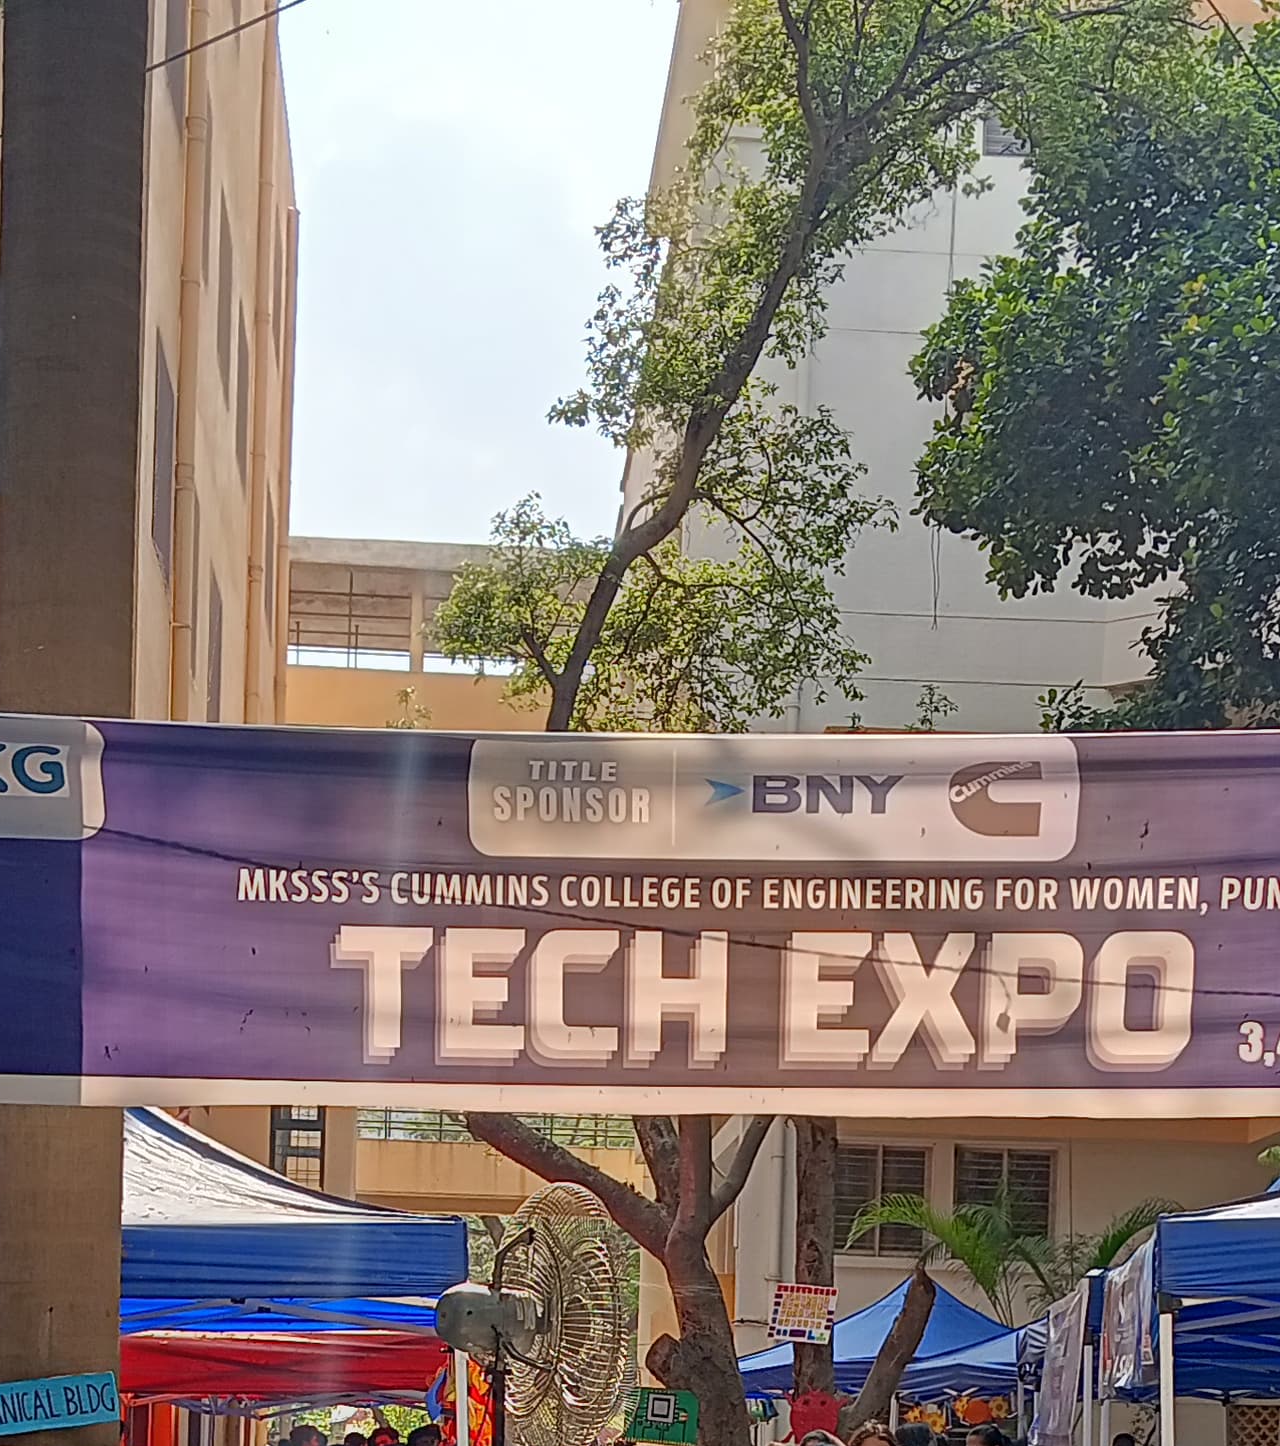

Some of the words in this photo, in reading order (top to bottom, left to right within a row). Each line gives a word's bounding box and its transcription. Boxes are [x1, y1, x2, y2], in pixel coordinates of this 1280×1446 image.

[528, 759, 617, 783] TITLE
[949, 761, 1032, 803] Cummins
[492, 786, 651, 824] SPONSOR
[751, 774, 905, 815] BNY
[237, 868, 380, 903] MKSSS'S
[390, 871, 549, 908] CUMMINS
[560, 875, 701, 910] COLLEGE
[712, 876, 751, 910] OF
[762, 876, 984, 911] ENGINEERING
[995, 877, 1057, 911] FOR
[1069, 876, 1209, 916] WOMEN,
[330, 924, 729, 1070] TECH
[778, 929, 1196, 1073] EXPO
[64, 1382, 116, 1416] BLDG
